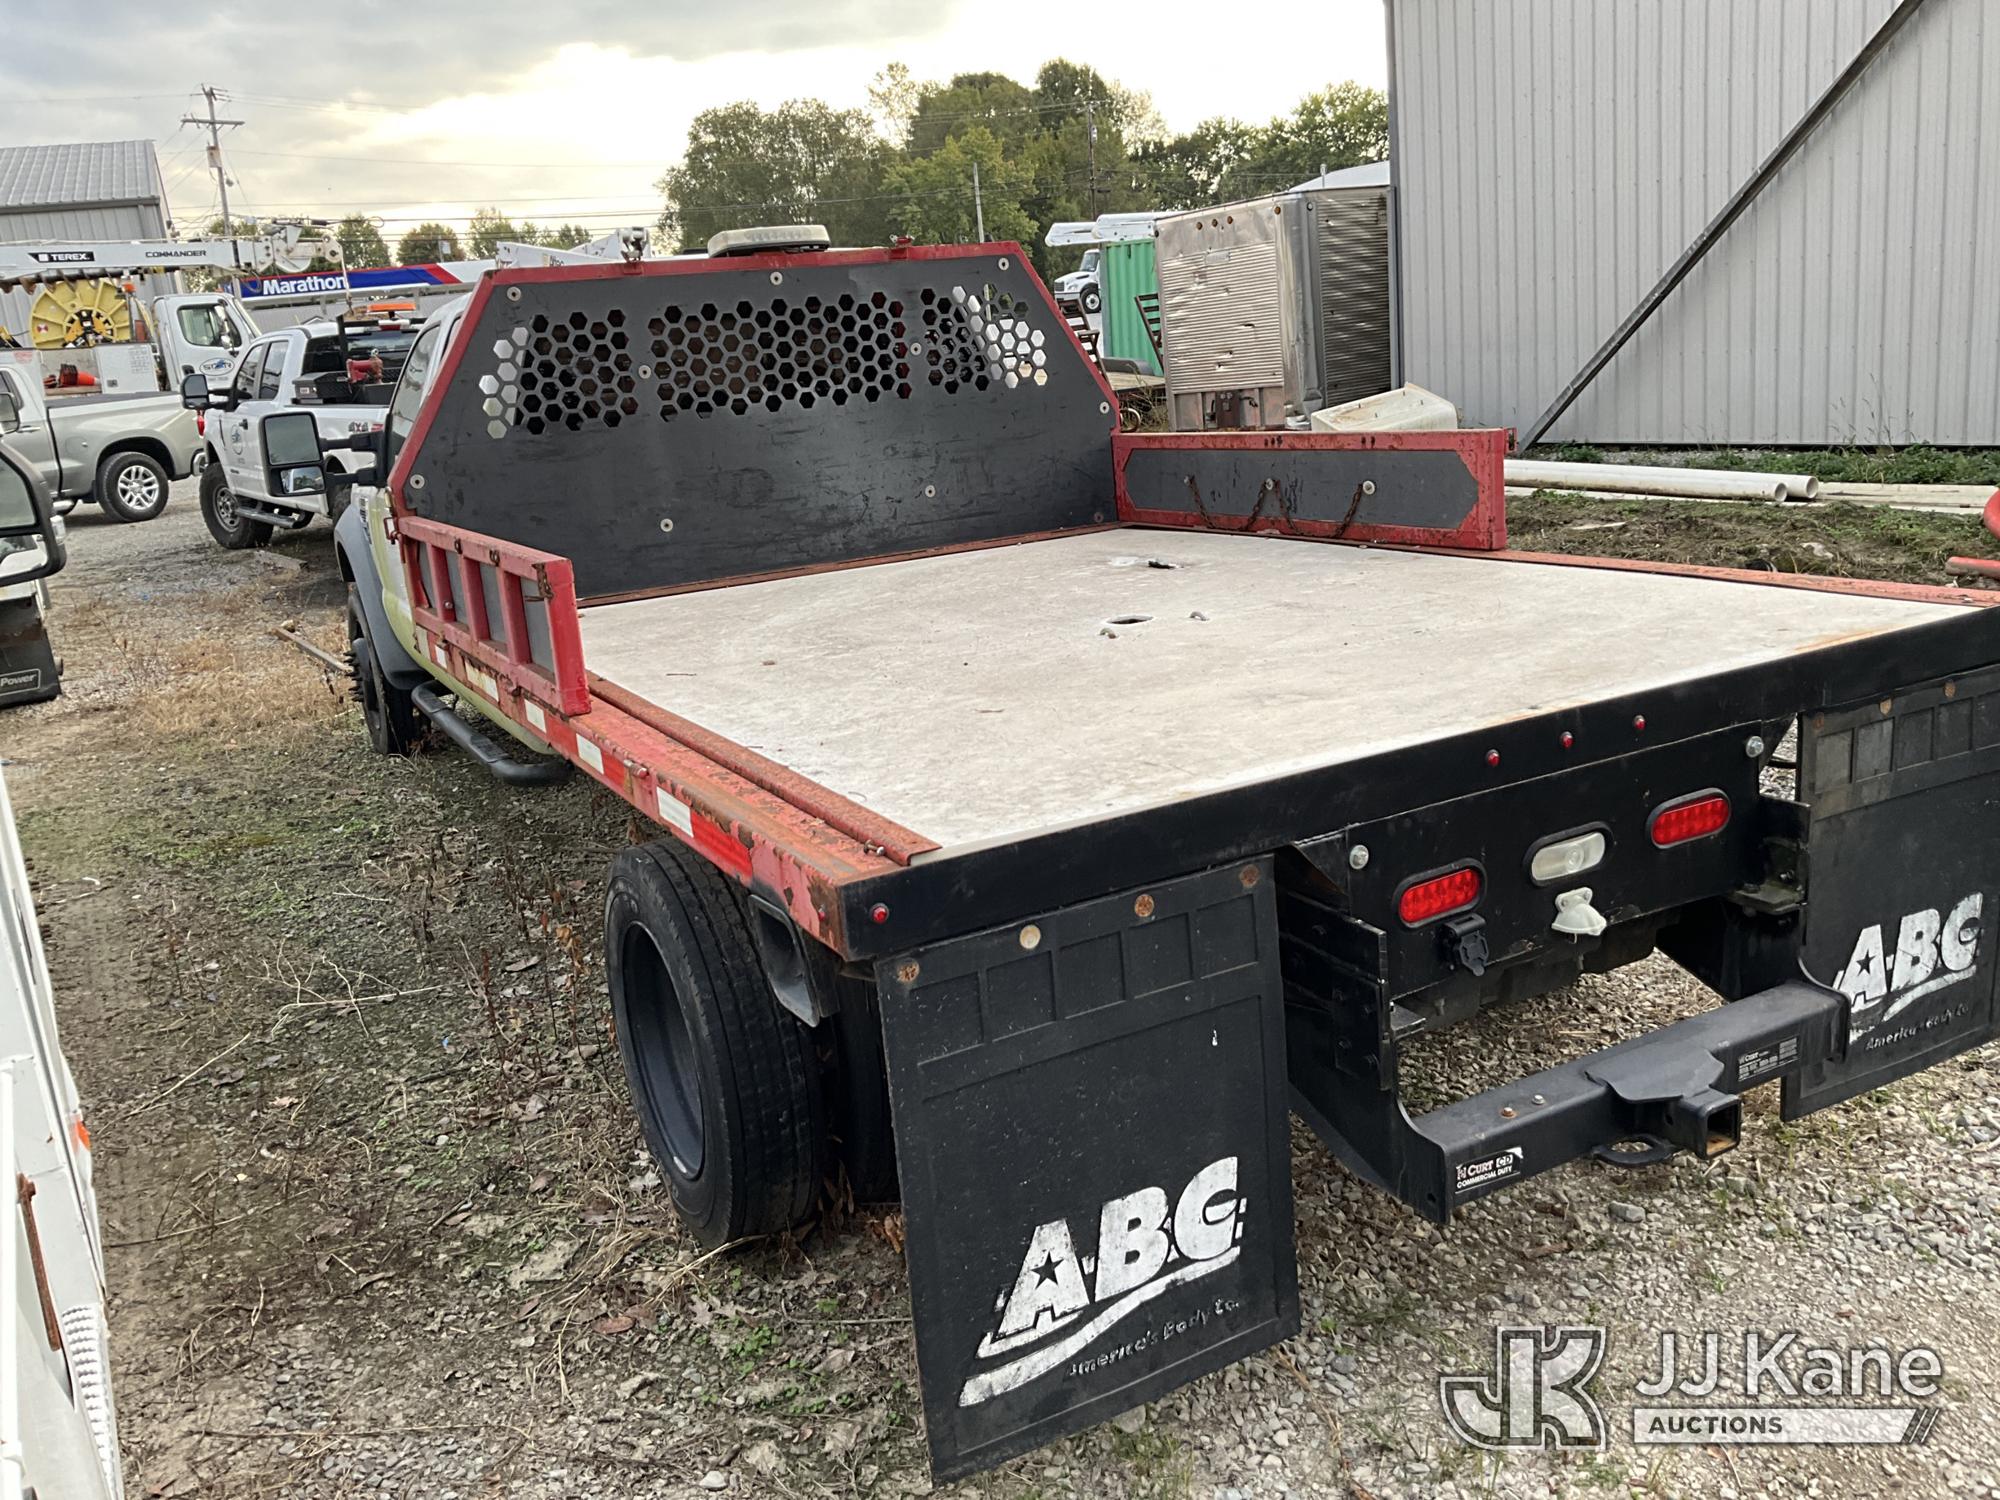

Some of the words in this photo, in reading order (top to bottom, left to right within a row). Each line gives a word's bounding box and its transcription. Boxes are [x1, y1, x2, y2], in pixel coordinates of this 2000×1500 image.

[51, 252, 88, 261] TEREX
[145, 249, 207, 258] COMMANDER
[262, 276, 348, 296] Marathon
[0, 674, 37, 687] Power
[1837, 891, 1984, 1007] ABC
[1865, 1025, 1925, 1050] America
[1456, 1170, 1496, 1188] COMMERCIAL
[1497, 1165, 1512, 1175] DUTY
[1468, 1160, 1493, 1176] CURT
[998, 1156, 1238, 1335] ABC
